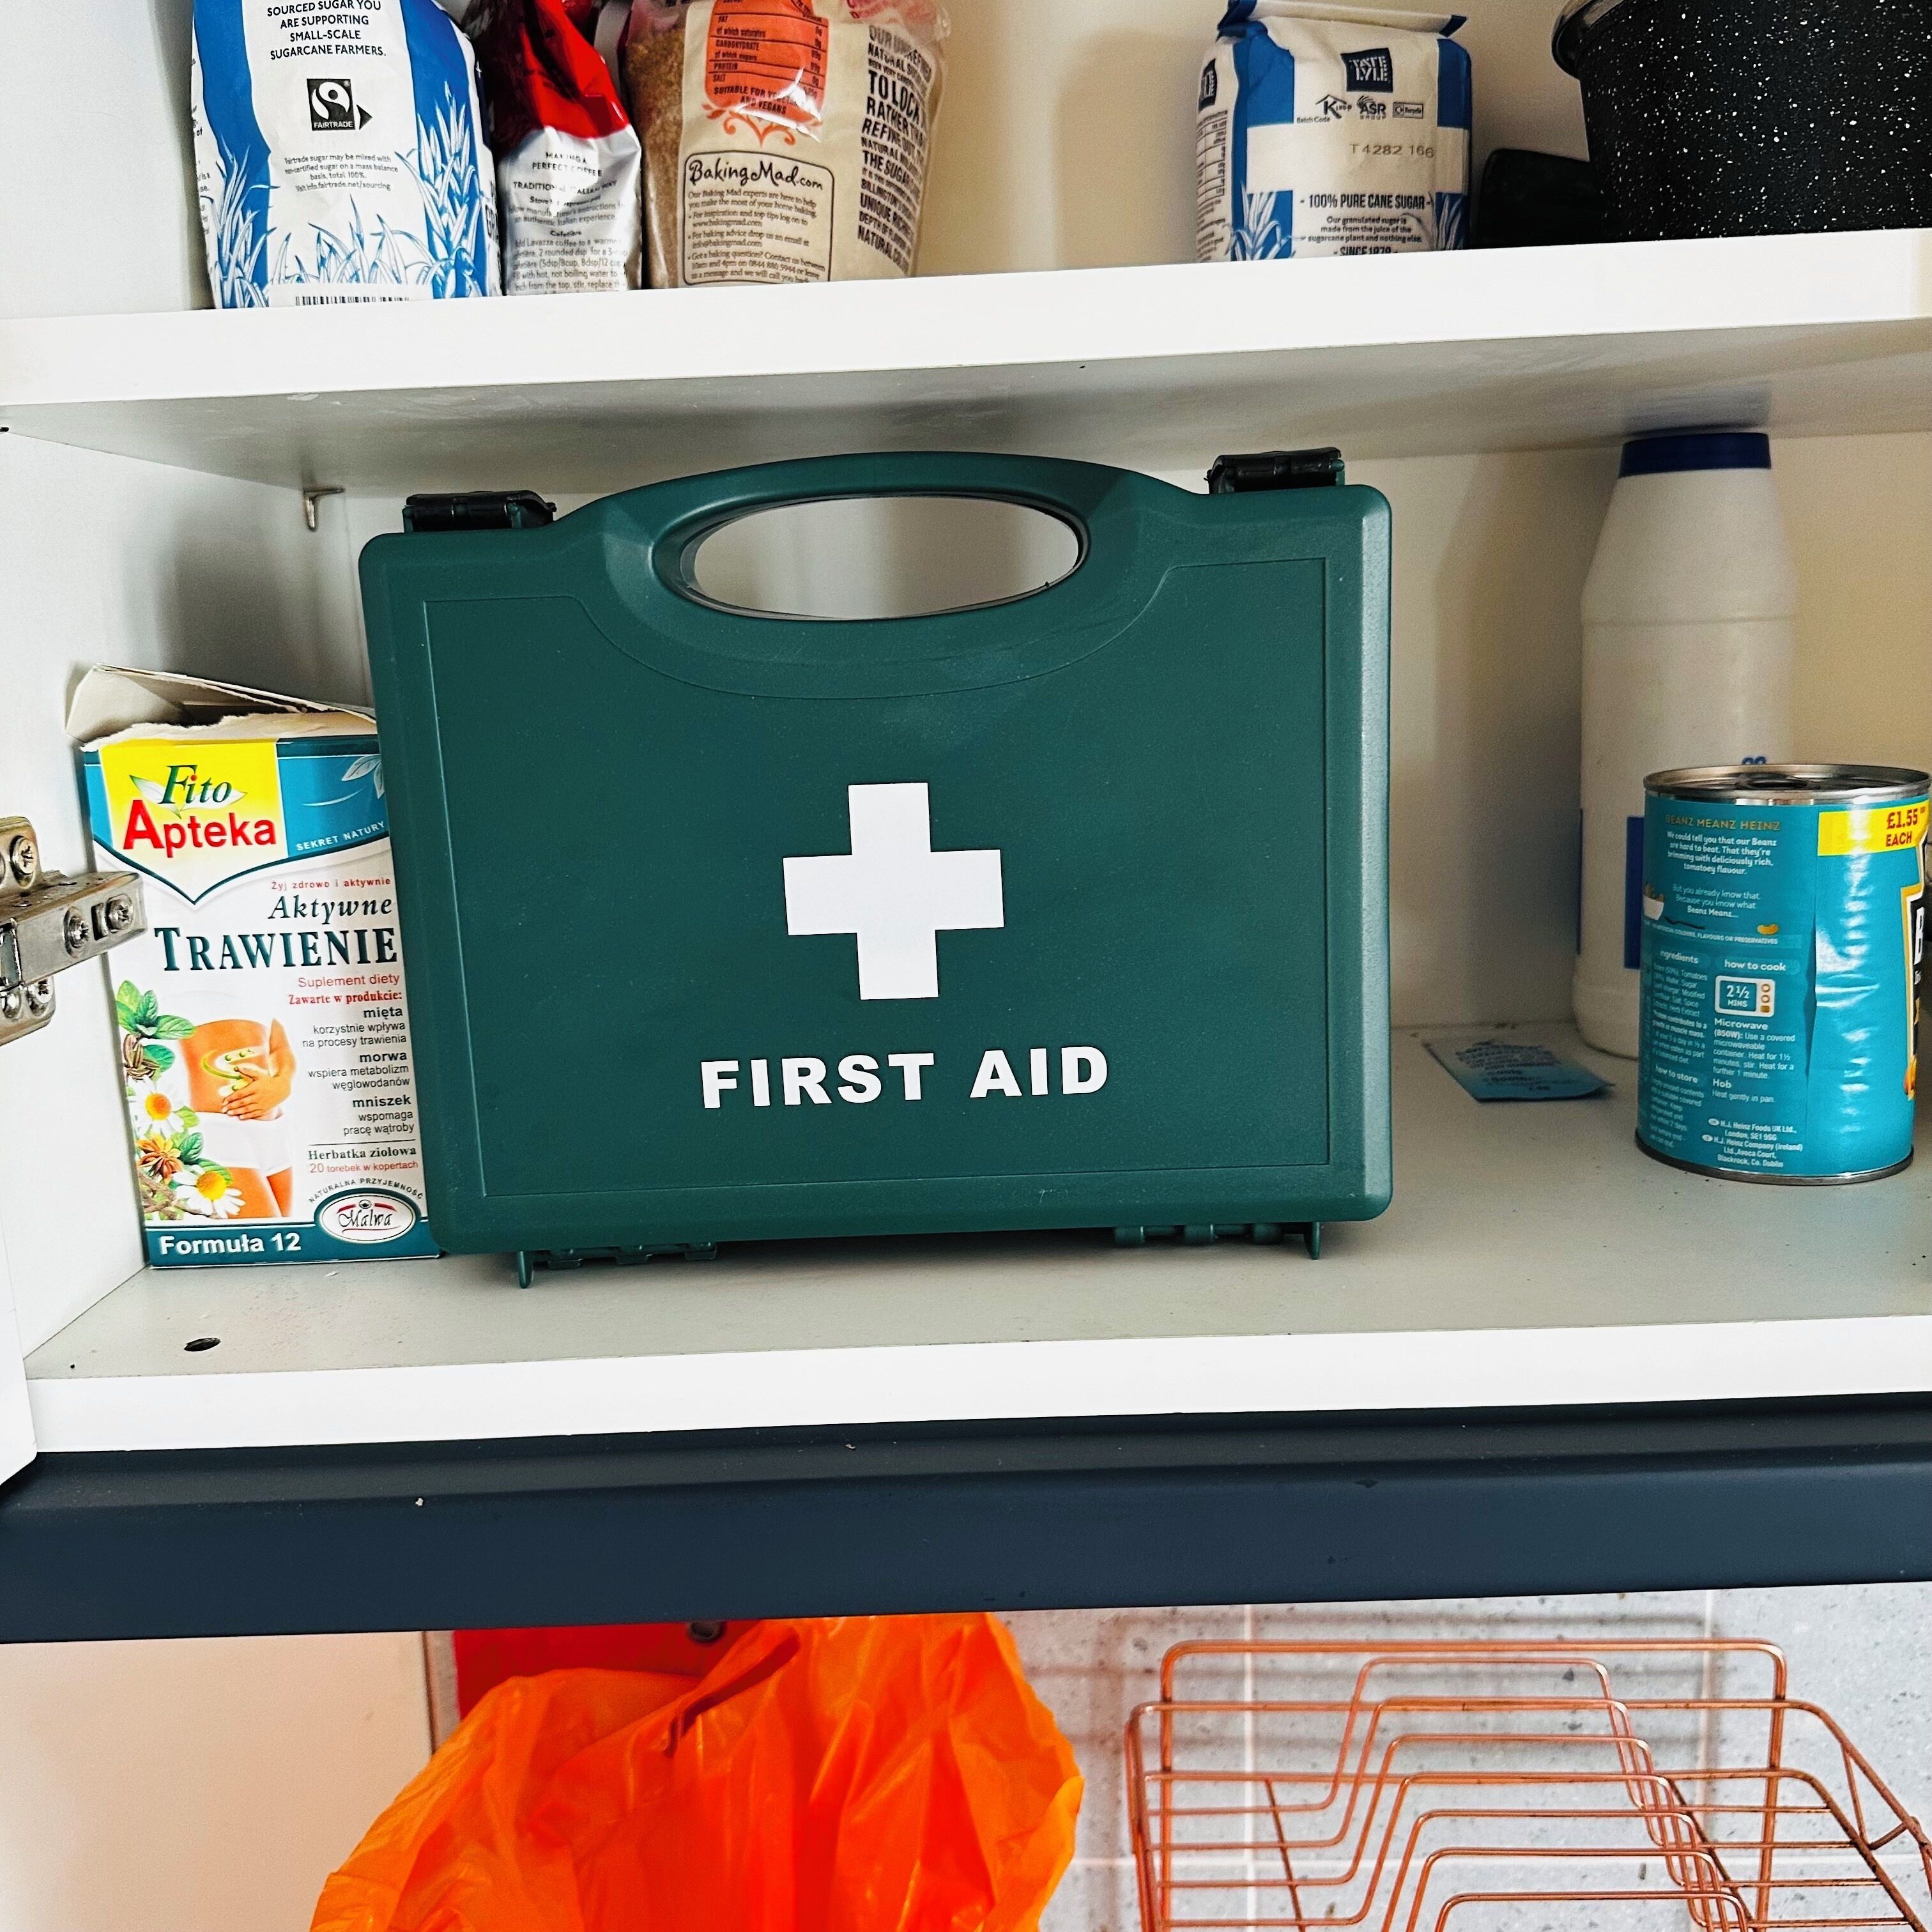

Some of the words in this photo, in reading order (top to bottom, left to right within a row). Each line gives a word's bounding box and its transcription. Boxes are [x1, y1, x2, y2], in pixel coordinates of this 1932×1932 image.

[267, 3, 316, 17] SOURCED
[318, 0, 355, 10] SUGAR
[355, 0, 381, 10] YOU
[280, 18, 299, 29] ARE
[302, 14, 369, 26] SUPPORTING
[289, 30, 362, 42] SMALL-SCALE
[270, 45, 333, 60] SUGARCANE
[335, 45, 387, 56] FARMERS.
[1349, 56, 1387, 68] TATE
[1355, 67, 1388, 82] LYLE
[714, 86, 748, 95] SUITABLE
[750, 87, 766, 97] FOR
[868, 70, 888, 100] TO
[758, 100, 786, 115] VEGANS
[1360, 103, 1386, 115] ASR
[866, 96, 908, 137] RATHER
[1362, 144, 1402, 156] 4282
[1409, 146, 1434, 158] 166
[310, 155, 328, 164] sugar
[862, 150, 884, 171] THE
[1309, 194, 1338, 208] 100%
[1340, 194, 1365, 208] PURE
[1368, 194, 1393, 209] CANE
[1395, 195, 1425, 210] SUGAR
[1326, 216, 1341, 224] Our
[1342, 217, 1381, 226] granulated
[1373, 226, 1390, 234] juice
[555, 239, 578, 248] coffee
[1308, 235, 1346, 244] sugarcane
[1346, 234, 1365, 243] plant
[1379, 236, 1406, 244] nothing
[158, 764, 233, 804] Fito
[1666, 815, 1693, 826] BEANZ
[1697, 819, 1736, 829] MEANZ
[1740, 820, 1781, 831] HEINZ
[1886, 808, 1919, 830] £1.55
[123, 799, 277, 859] Apteka
[296, 836, 339, 851] SEKRET
[343, 821, 385, 841] NATURY
[1675, 833, 1691, 841] could
[1704, 836, 1717, 845] you
[1718, 836, 1735, 845] that
[1752, 838, 1777, 847] Beanz
[1885, 831, 1912, 847] EACH
[1679, 842, 1693, 850] hard
[1703, 845, 1720, 854] beat.
[1722, 846, 1740, 855] That
[1742, 847, 1771, 857] they're
[1667, 851, 1694, 862] brimming
[1695, 854, 1710, 862] with
[1712, 855, 1753, 867] deliciously
[1754, 857, 1774, 866] rich,
[1683, 862, 1716, 875] tomatoey
[1717, 865, 1747, 875] flavour.
[271, 880, 288, 891] Żyj
[293, 880, 330, 889] zdrowo
[344, 877, 391, 889] aktywnie
[1695, 887, 1721, 898] already
[1721, 889, 1742, 898] know
[1676, 894, 1700, 905] Because
[1701, 899, 1714, 907] you
[1715, 898, 1735, 908] know
[1736, 900, 1756, 909] what
[268, 894, 393, 925] Aktywne
[1687, 905, 1707, 914] Beanz
[1697, 932, 1724, 942] FLAVOURS
[1734, 936, 1779, 945] PRESERVATIVES
[154, 927, 397, 971] TRAWIENIE
[1724, 959, 1745, 969] how
[1747, 962, 1758, 970] to
[1760, 962, 1786, 971] cook
[298, 975, 366, 988] Suplement
[369, 974, 400, 985] diety
[289, 994, 331, 1004] Zawarte
[346, 990, 402, 1004] produkcie:
[363, 1006, 403, 1020] mięta
[314, 1023, 365, 1035] korzystnie
[367, 1022, 406, 1034] wpływa
[1714, 1017, 1768, 1030] Microwave
[318, 1038, 357, 1048] procesy
[360, 1034, 407, 1045] trawienia
[1744, 1032, 1759, 1040] Use
[359, 1052, 407, 1062] morwa
[308, 1067, 348, 1079] wspiera
[351, 1064, 409, 1076] metabolizm
[701, 1052, 934, 1109] FIRST
[969, 1046, 1108, 1099] AID
[332, 1077, 410, 1091] węglowodanów
[1713, 1078, 1732, 1089] Hob
[352, 1094, 411, 1108] mniszek
[358, 1110, 413, 1123] wspomaga
[343, 1126, 371, 1137] pracę
[374, 1123, 415, 1135] wątroby
[308, 1147, 366, 1160] Herbatka
[369, 1146, 417, 1157] ziołowa
[310, 1163, 325, 1174] 20
[327, 1163, 361, 1172] torebek
[373, 1161, 418, 1172] kopertach
[309, 1179, 357, 1204] NATURALNA
[360, 1177, 424, 1200] PRZYJEMNOŚĆ
[338, 1208, 393, 1228] Malwa
[160, 1234, 265, 1255] Formuła
[270, 1232, 302, 1252] 12
